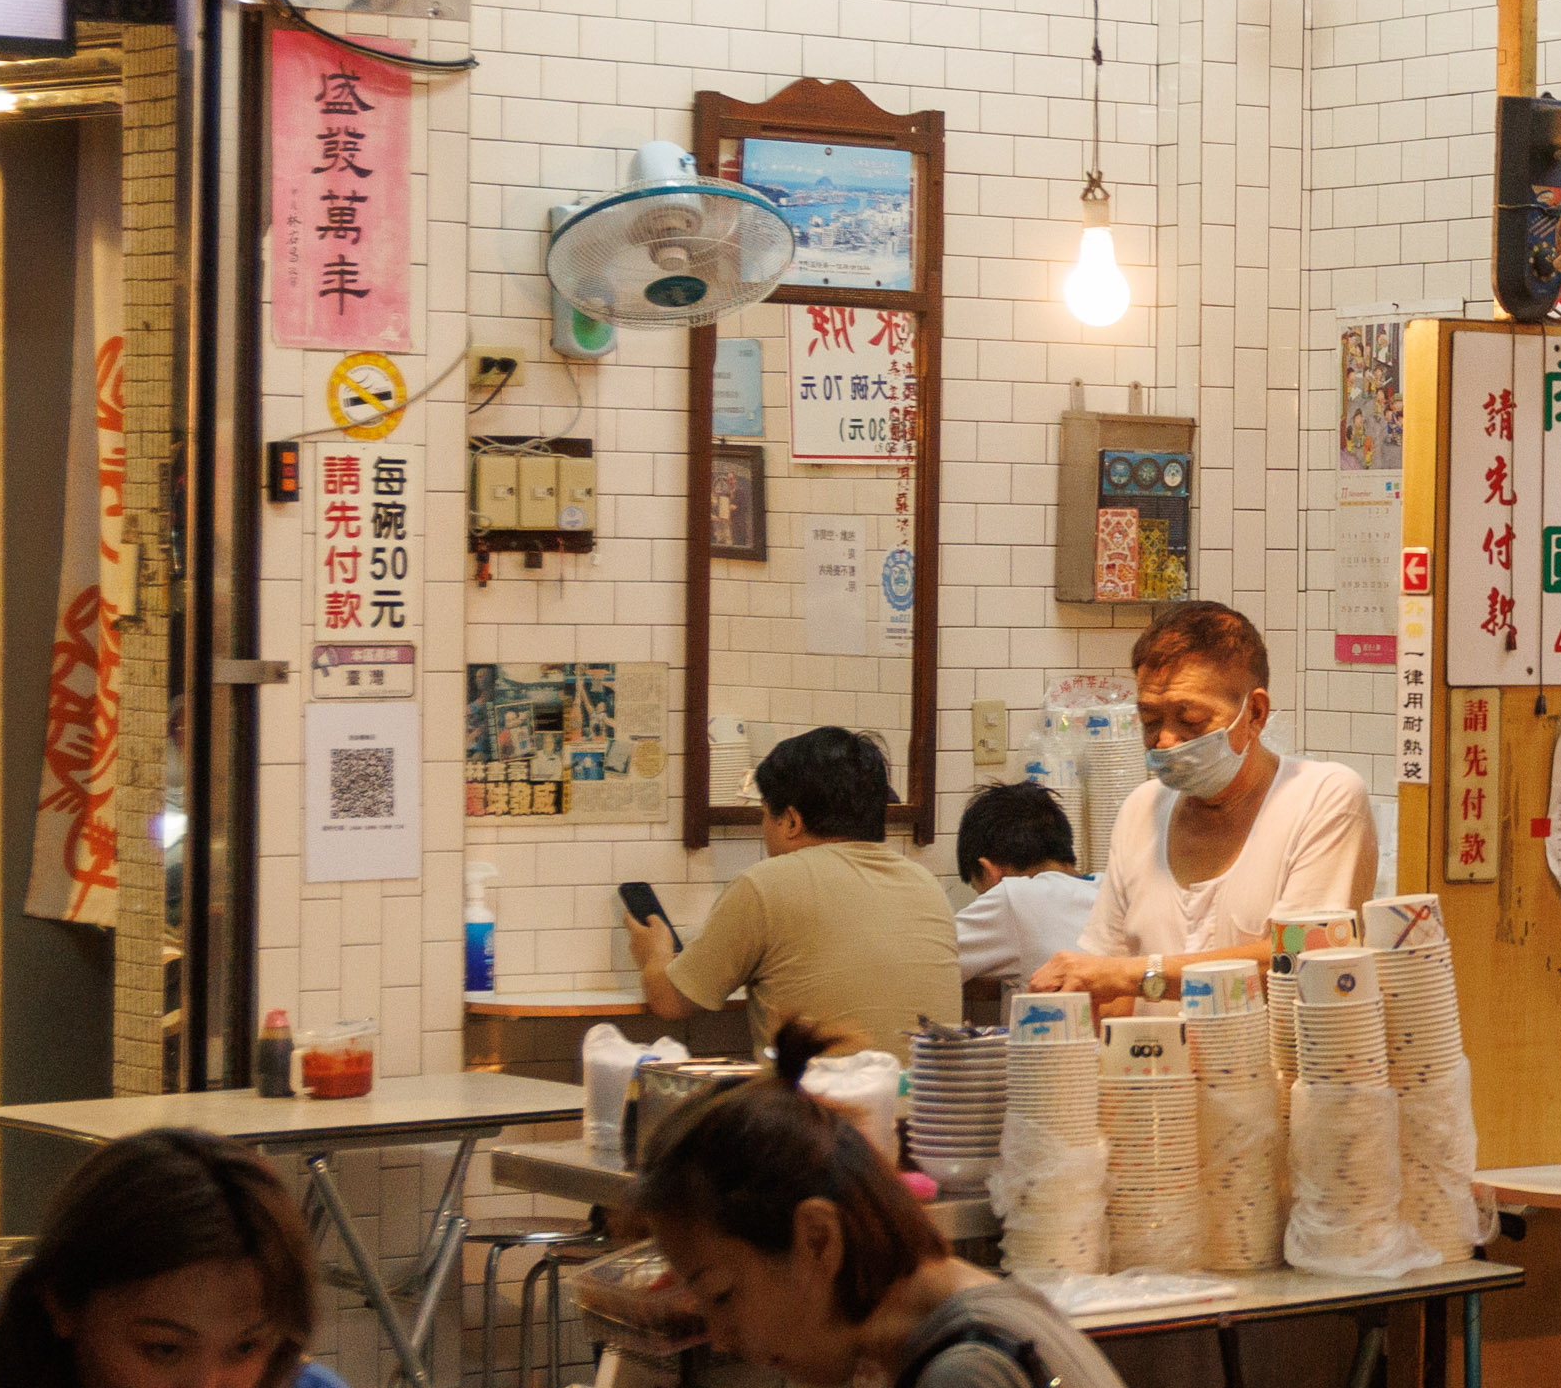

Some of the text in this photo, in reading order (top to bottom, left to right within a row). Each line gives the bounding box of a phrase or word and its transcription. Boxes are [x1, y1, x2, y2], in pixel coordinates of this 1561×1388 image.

[323, 455, 362, 630] 請先付款
[369, 456, 408, 629] 每碗50元
[1480, 389, 1518, 639] 請先付款
[1460, 699, 1488, 866] 請先付款
